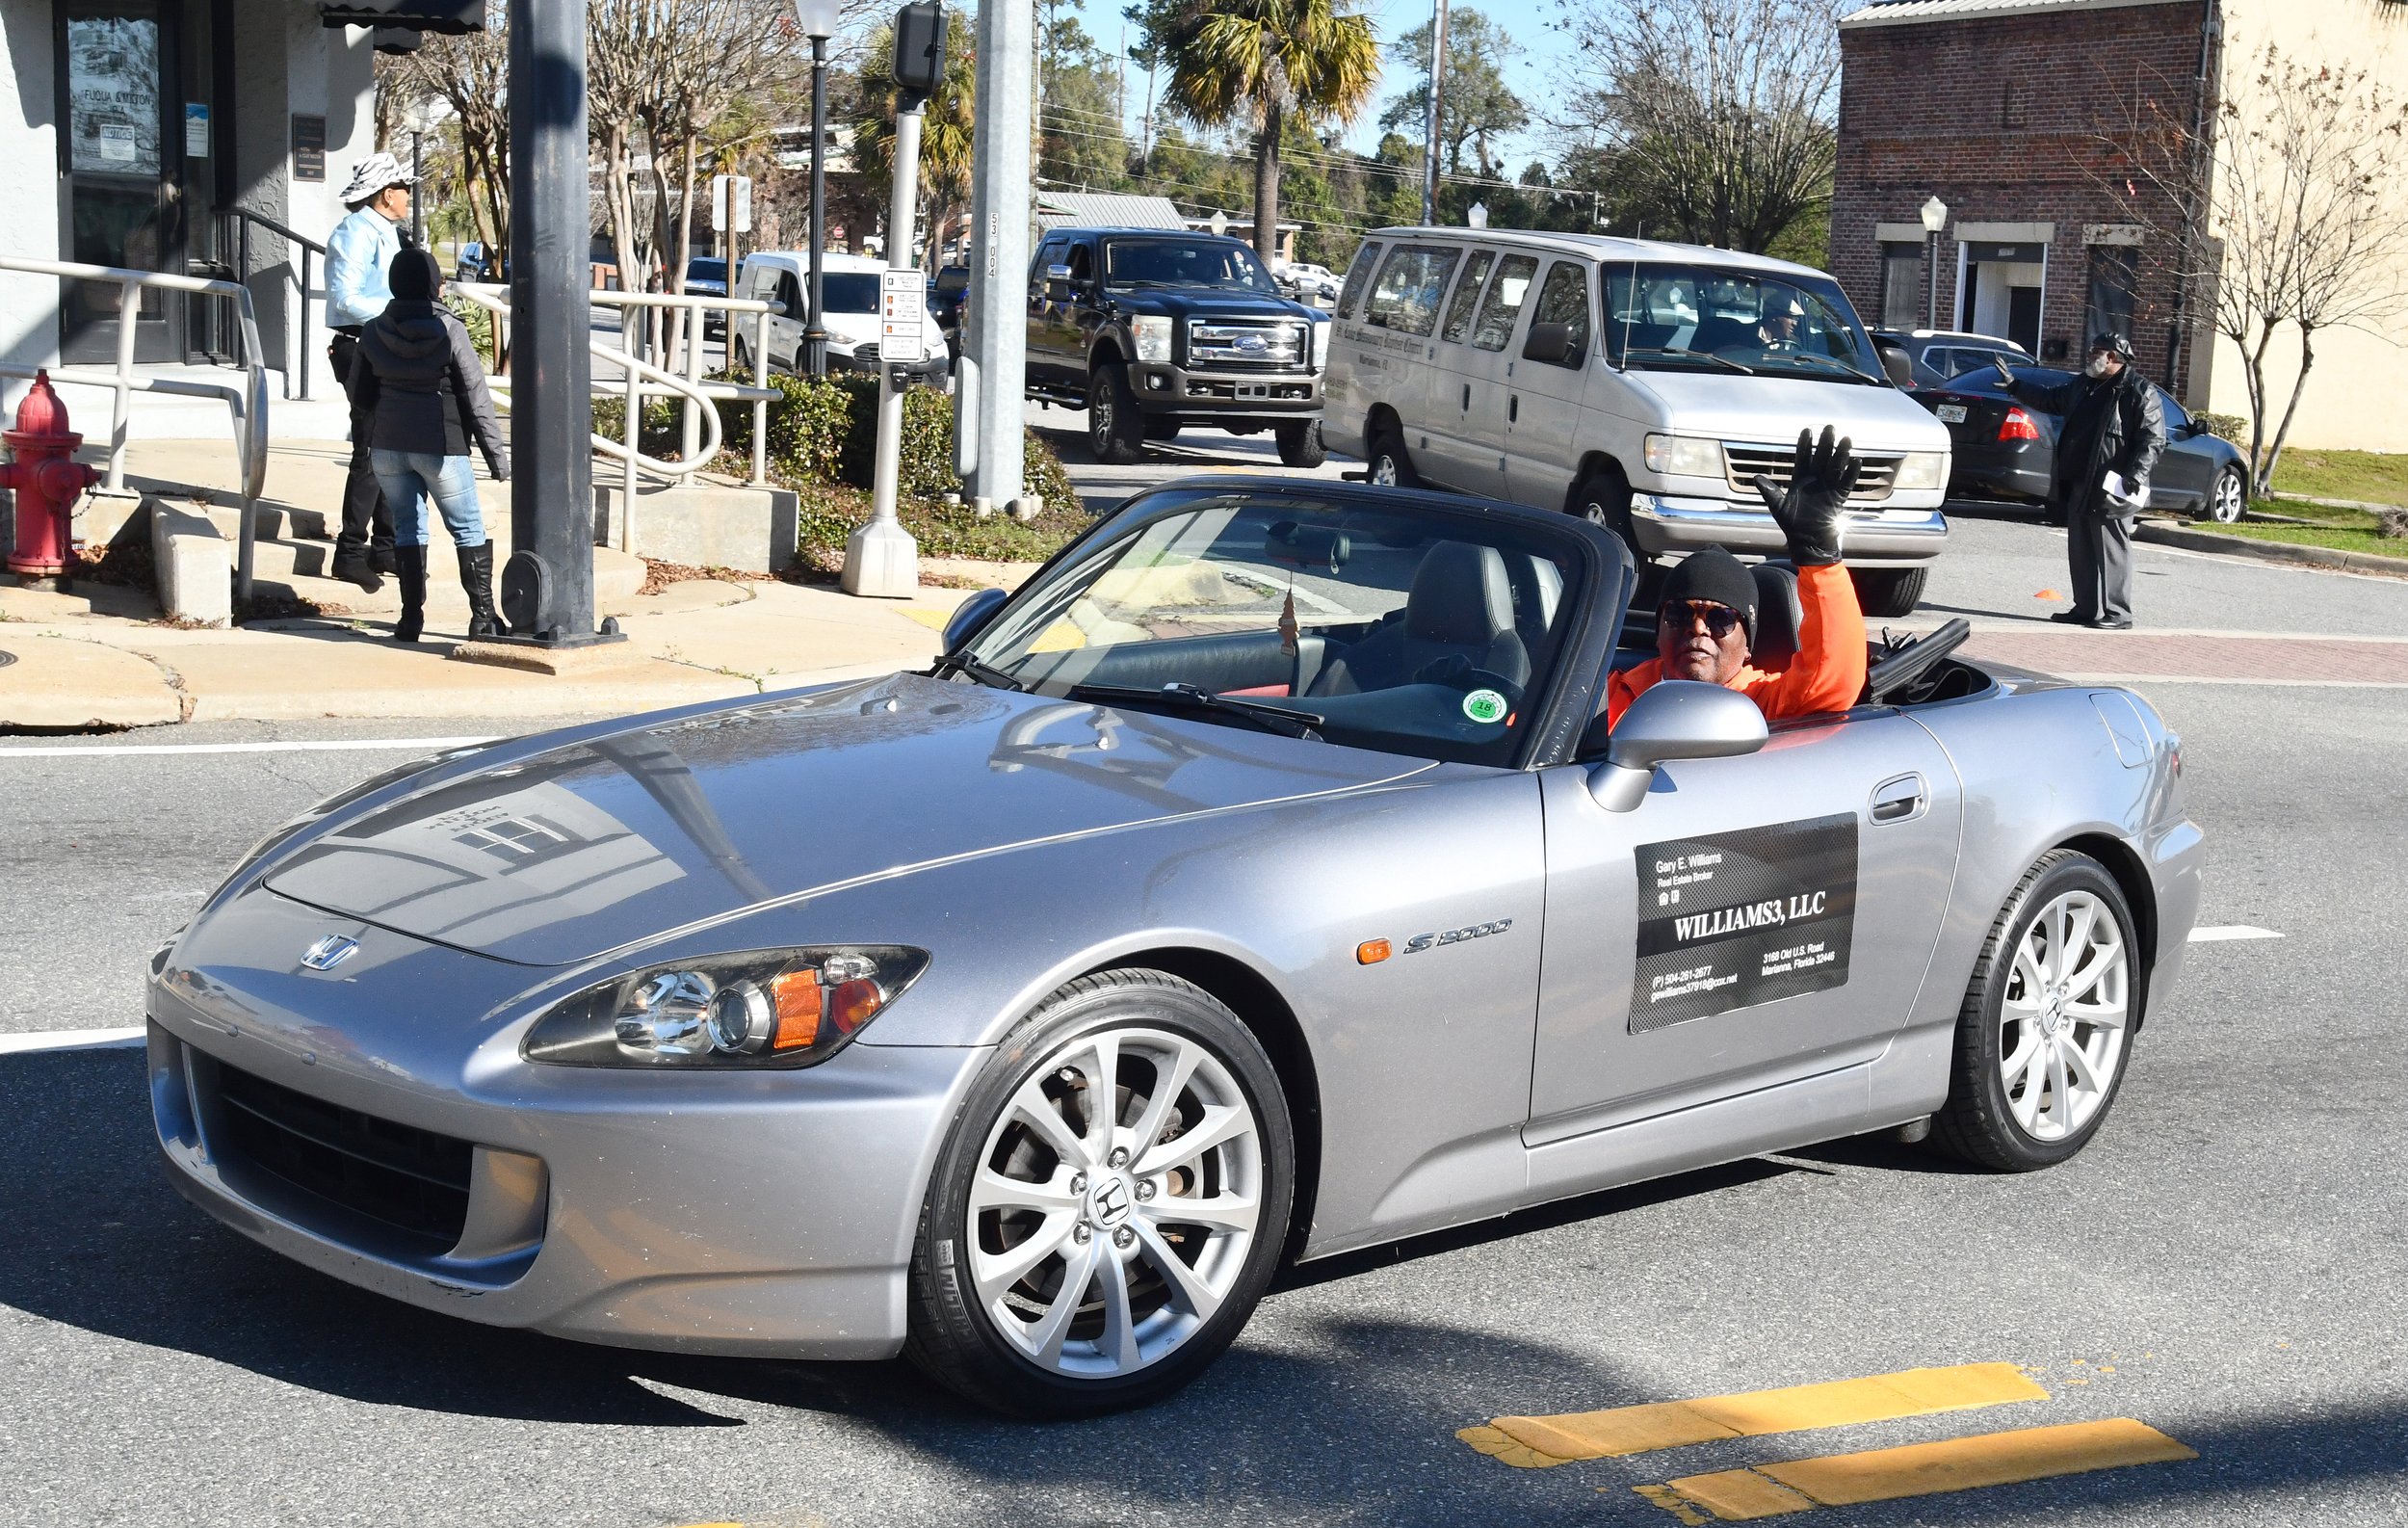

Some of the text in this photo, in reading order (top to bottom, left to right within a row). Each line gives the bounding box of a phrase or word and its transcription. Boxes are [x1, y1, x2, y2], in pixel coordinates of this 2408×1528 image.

[85, 90, 112, 102] FUQUA
[103, 126, 133, 140] NOTICE
[1477, 701, 1492, 711] 18
[1656, 854, 1722, 873] Gary E. Williams
[1657, 871, 1714, 887] Real Estate Broker
[1675, 891, 1826, 941] WILLIAMS3, LLC
[1780, 948, 1792, 960] Old
[1793, 945, 1806, 957] U.S.
[1807, 941, 1824, 954] Road
[1762, 962, 1793, 976] Marianna,
[1793, 956, 1815, 969] Florida
[1652, 965, 1713, 989] (P) 504-261-2677
